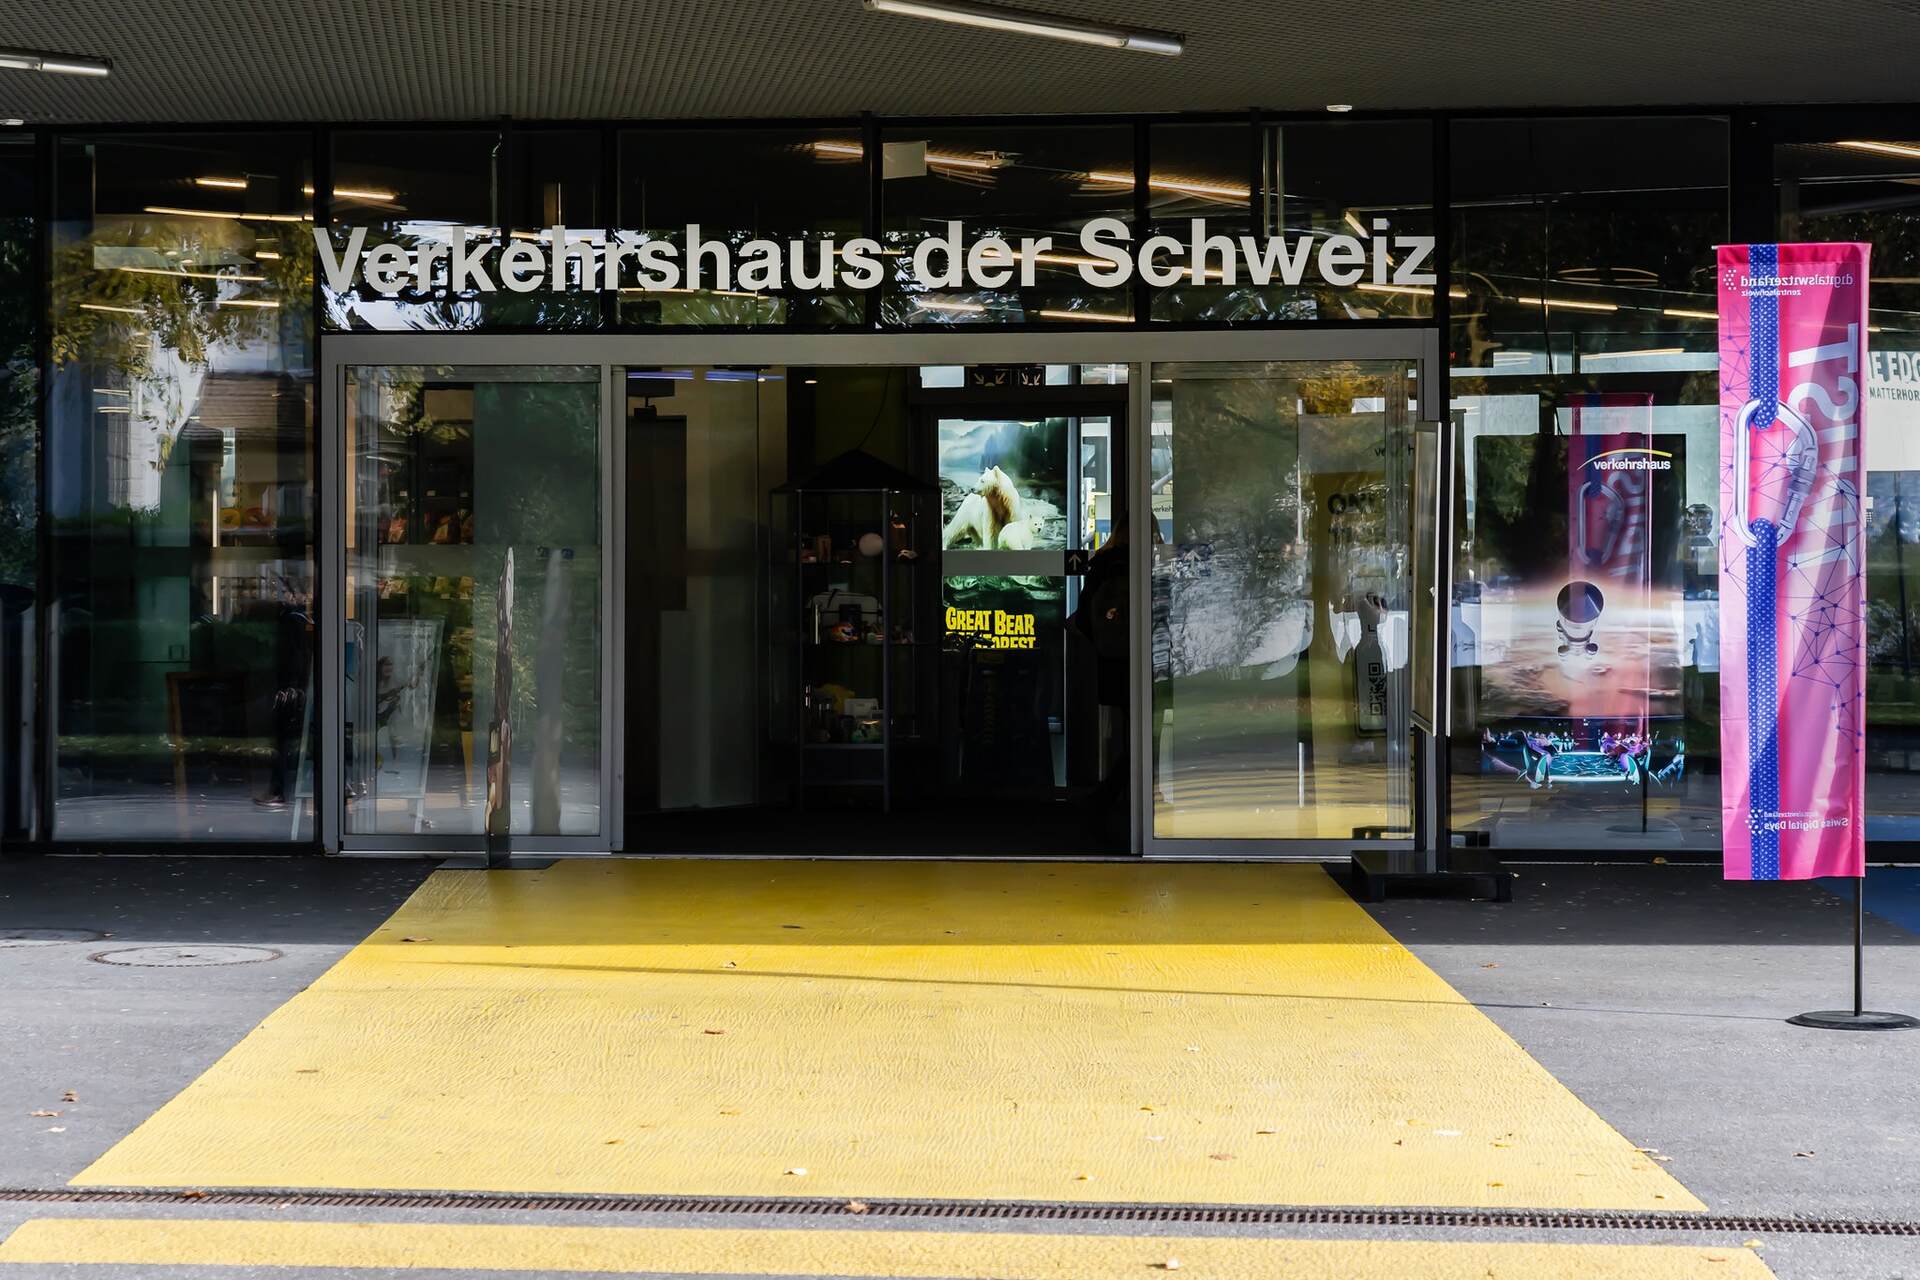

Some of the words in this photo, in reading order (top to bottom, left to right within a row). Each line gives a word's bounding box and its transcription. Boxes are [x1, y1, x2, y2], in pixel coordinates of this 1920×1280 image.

[312, 223, 885, 293] Verkehrshaus
[912, 220, 1053, 288] der
[1078, 217, 1437, 288] Schweiz
[1593, 457, 1671, 470] verkehrshaus
[945, 607, 992, 631] GREAT
[994, 609, 1035, 636] BEAR
